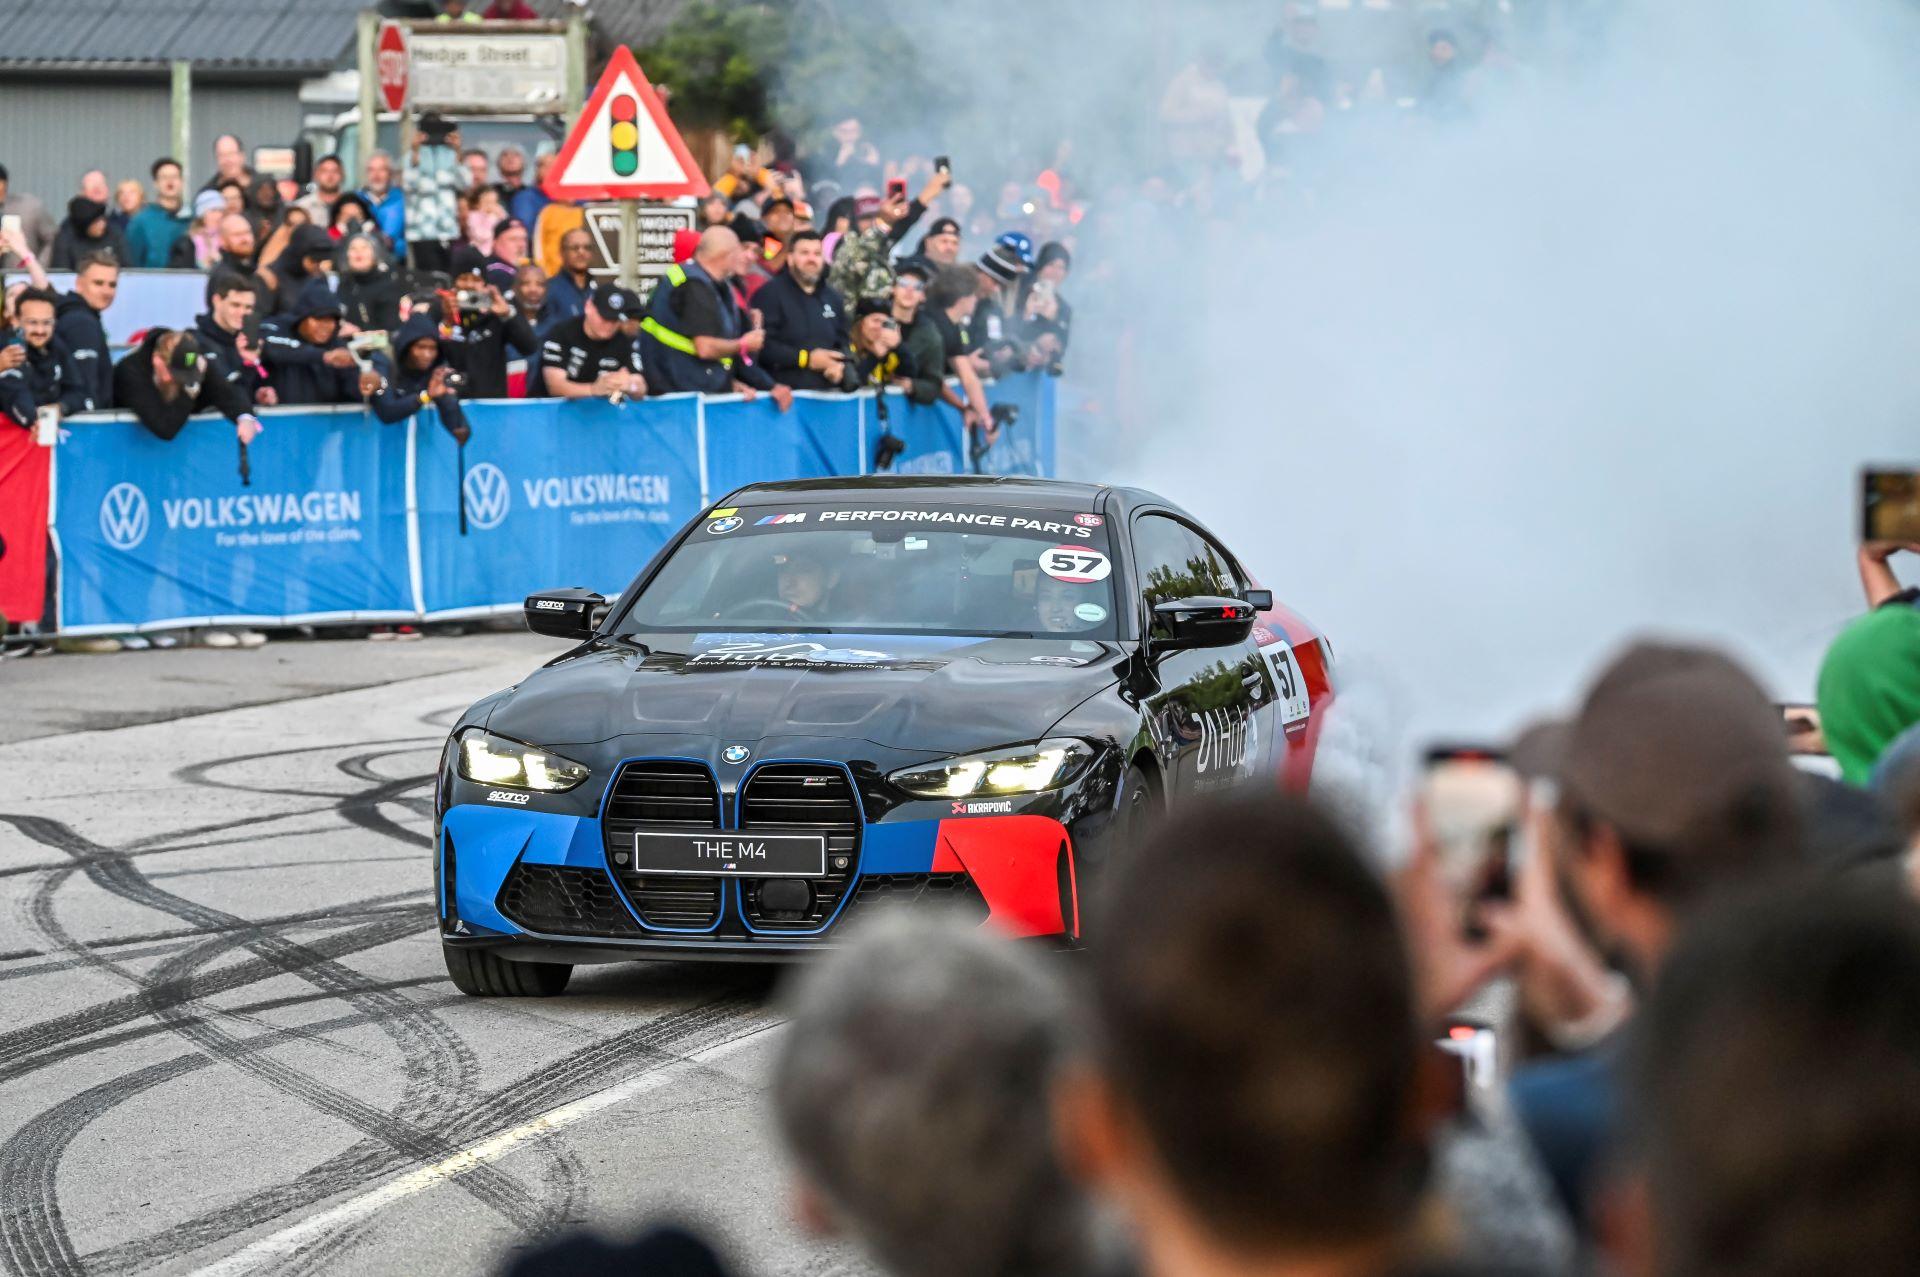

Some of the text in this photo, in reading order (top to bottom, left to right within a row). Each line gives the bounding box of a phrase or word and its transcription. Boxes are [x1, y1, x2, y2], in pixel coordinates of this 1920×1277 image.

[477, 45, 529, 61] Street
[522, 473, 670, 509] VOLKSWAGEN
[162, 490, 361, 529] VOLKSWAGEN
[818, 510, 1007, 527] PERFORMANCE
[1010, 517, 1092, 538] PARTS
[215, 532, 236, 547] For
[238, 530, 259, 546] the
[289, 528, 304, 544] of
[1049, 554, 1103, 574] 57
[536, 600, 564, 610] sparco
[691, 653, 794, 663] Hub
[1269, 650, 1297, 700] 57
[487, 791, 530, 804] sparco
[693, 841, 766, 859] THE M4
